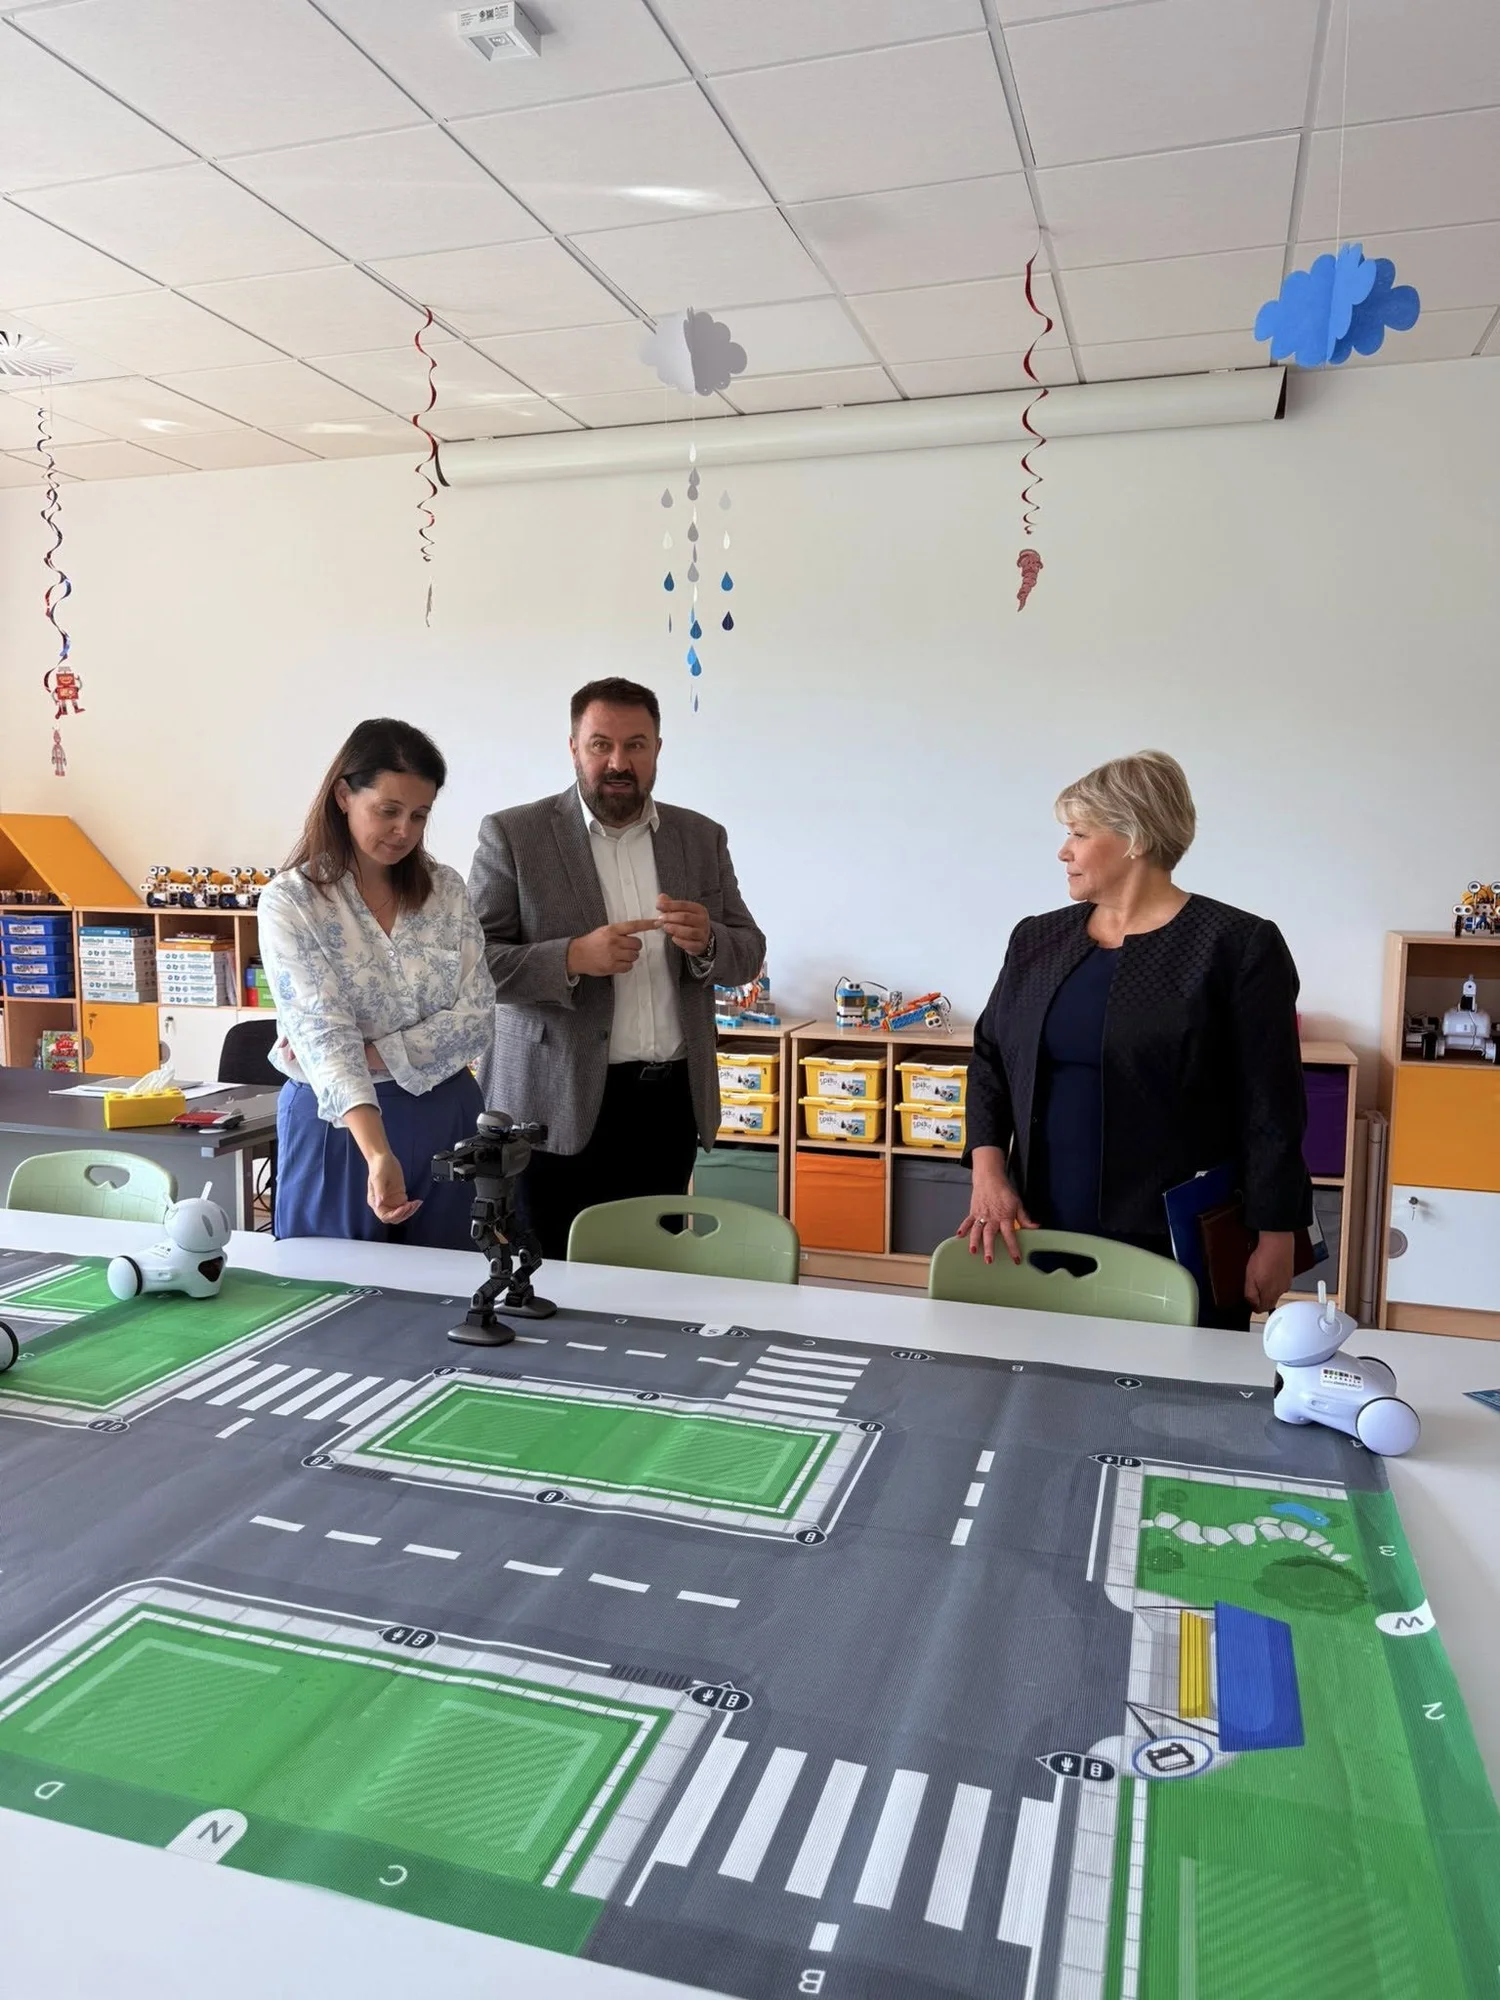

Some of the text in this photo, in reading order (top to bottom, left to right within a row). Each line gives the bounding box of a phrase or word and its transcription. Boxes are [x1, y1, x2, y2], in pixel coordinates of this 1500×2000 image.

[707, 1328, 720, 1336] S
[1239, 1391, 1254, 1399] A
[1395, 1616, 1424, 1630] W
[1422, 1701, 1446, 1720] 2
[34, 1781, 66, 1800] D
[196, 1819, 234, 1845] N
[378, 1864, 408, 1887] C
[797, 1968, 826, 1994] B
